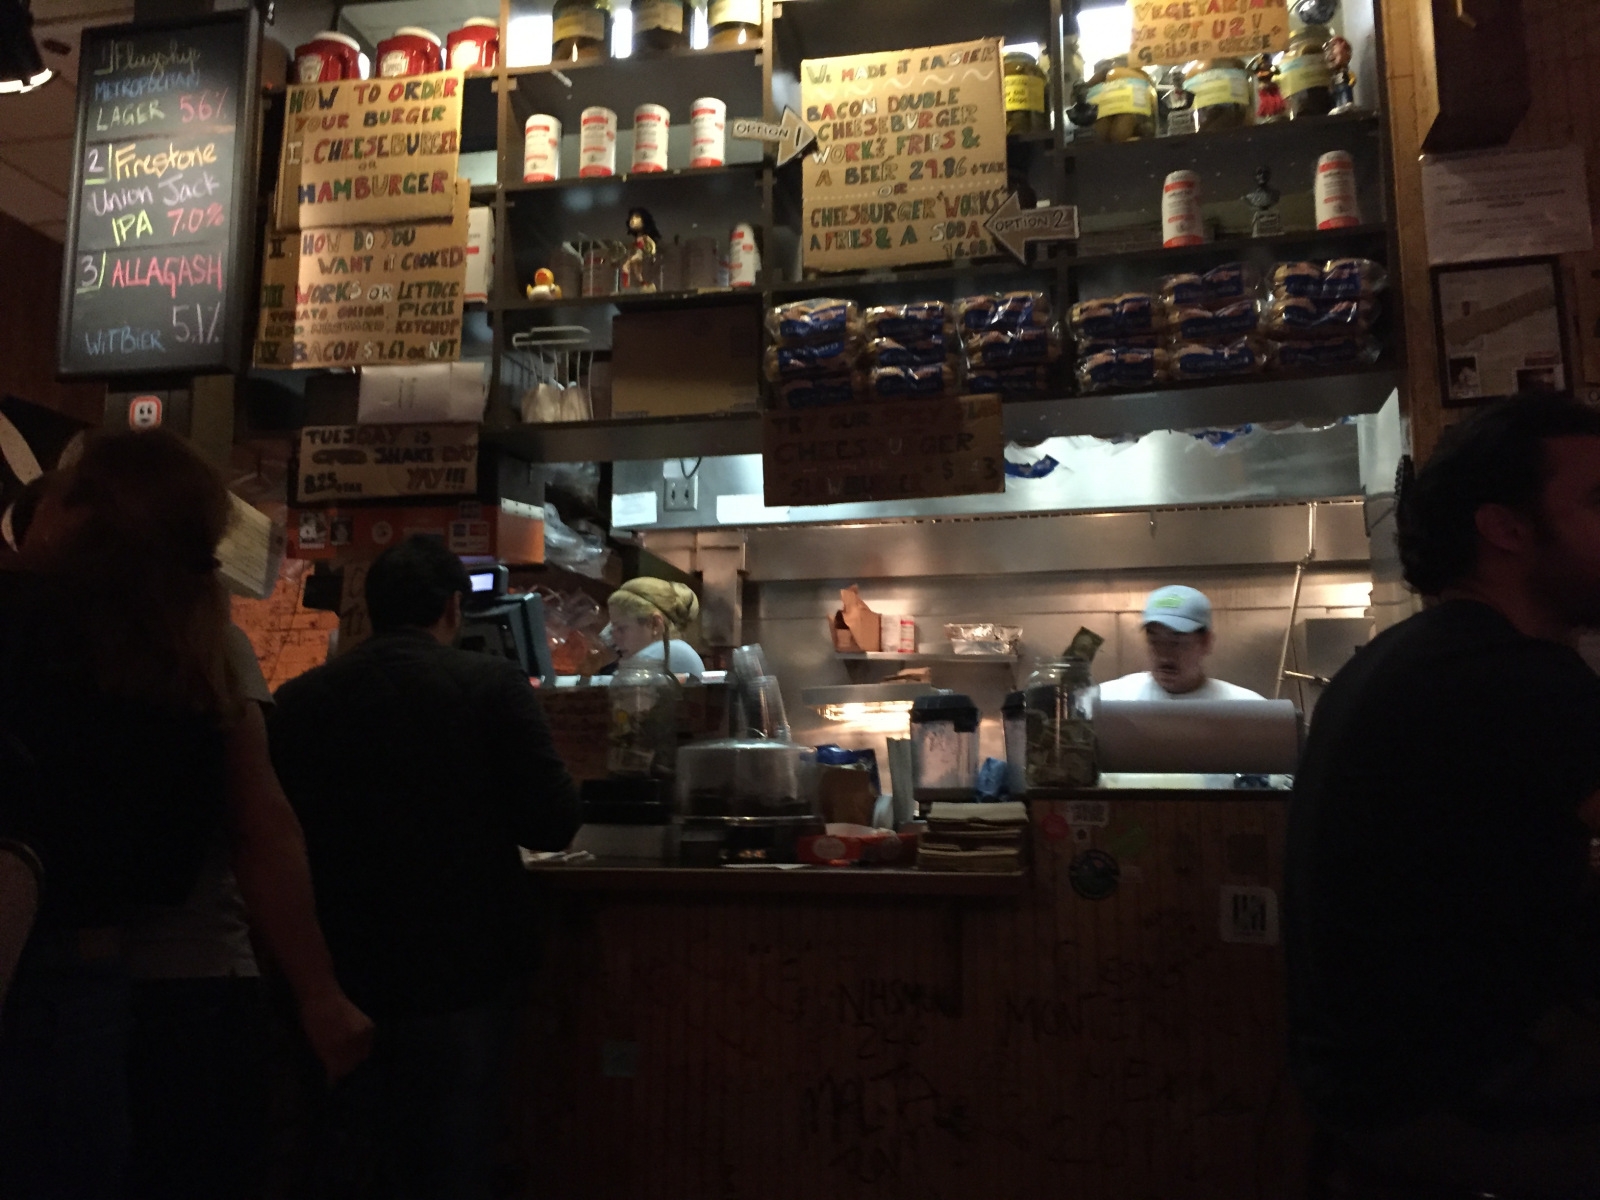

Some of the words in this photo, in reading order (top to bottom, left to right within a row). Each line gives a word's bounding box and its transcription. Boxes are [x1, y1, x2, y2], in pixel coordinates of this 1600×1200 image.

[842, 64, 887, 82] MADE
[920, 46, 996, 70] EASIER
[289, 85, 339, 113] HOW
[354, 83, 381, 104] TO
[388, 77, 458, 103] ORDER
[806, 97, 878, 122] BACON
[888, 86, 960, 113] DOUBLE
[96, 101, 165, 131] LAGER
[295, 114, 349, 132] YOUR
[363, 105, 447, 127] BURGER
[736, 122, 789, 138] OPTION
[817, 105, 978, 142] CHEESEBURGER
[313, 130, 458, 164] CHEESEBURGER
[896, 130, 956, 156] FRIES
[115, 142, 217, 182] Firestone
[297, 170, 448, 204] HAMBURGER
[816, 169, 833, 187] A
[878, 182, 908, 198] OR
[91, 189, 154, 217] Union
[158, 171, 220, 206] Jack
[111, 209, 153, 247] IPA
[166, 204, 224, 237] 7.0%
[825, 228, 873, 250] FRIES
[900, 225, 918, 246] A
[930, 220, 980, 243] SODA
[995, 216, 1048, 232] OPTION
[1053, 209, 1069, 228] 2
[302, 231, 341, 256] HOW
[353, 229, 374, 250] DO
[111, 252, 223, 299] ALLAGASH
[318, 255, 373, 275] WANT
[295, 281, 362, 304] WORKS
[367, 284, 394, 302] OR
[294, 341, 358, 363] BACON
[429, 338, 458, 359] NOT
